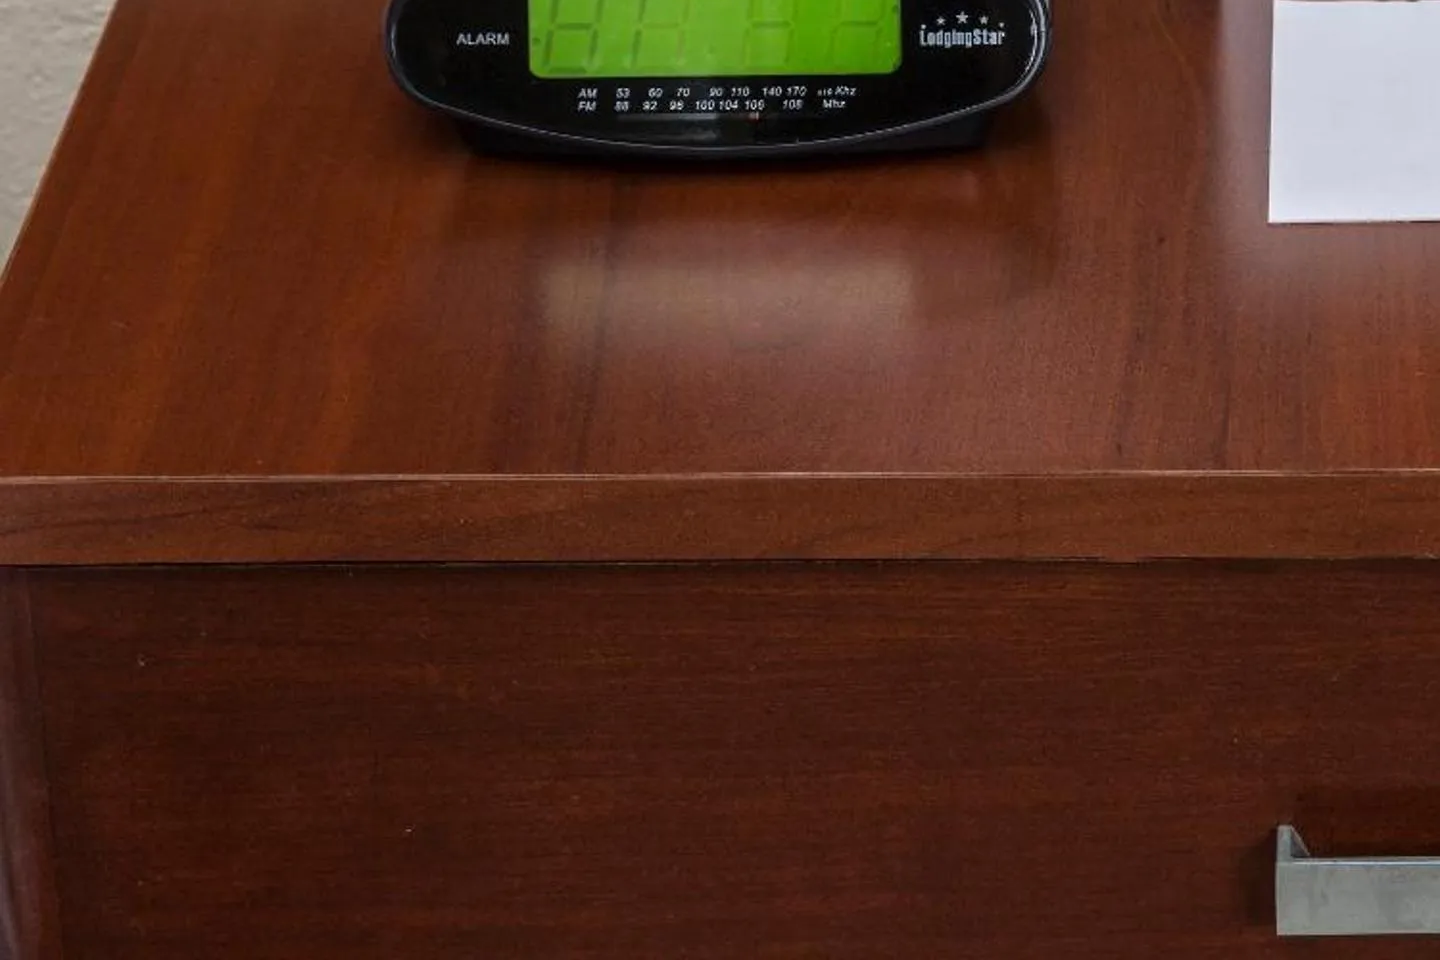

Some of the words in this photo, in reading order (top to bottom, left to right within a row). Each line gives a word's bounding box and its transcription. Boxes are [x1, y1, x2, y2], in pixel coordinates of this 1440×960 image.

[456, 32, 510, 46] ALARM
[919, 28, 1005, 48] LodgingStar
[578, 88, 598, 98] AM
[616, 88, 630, 99] 53
[648, 88, 663, 98] 60
[677, 87, 691, 97] 70
[709, 87, 723, 97] 90
[731, 87, 750, 97] 110
[762, 86, 782, 97] 140
[787, 86, 807, 97] 170
[577, 101, 597, 111] FM
[642, 101, 658, 111] 92
[695, 100, 716, 110] 100
[719, 100, 739, 110] 104
